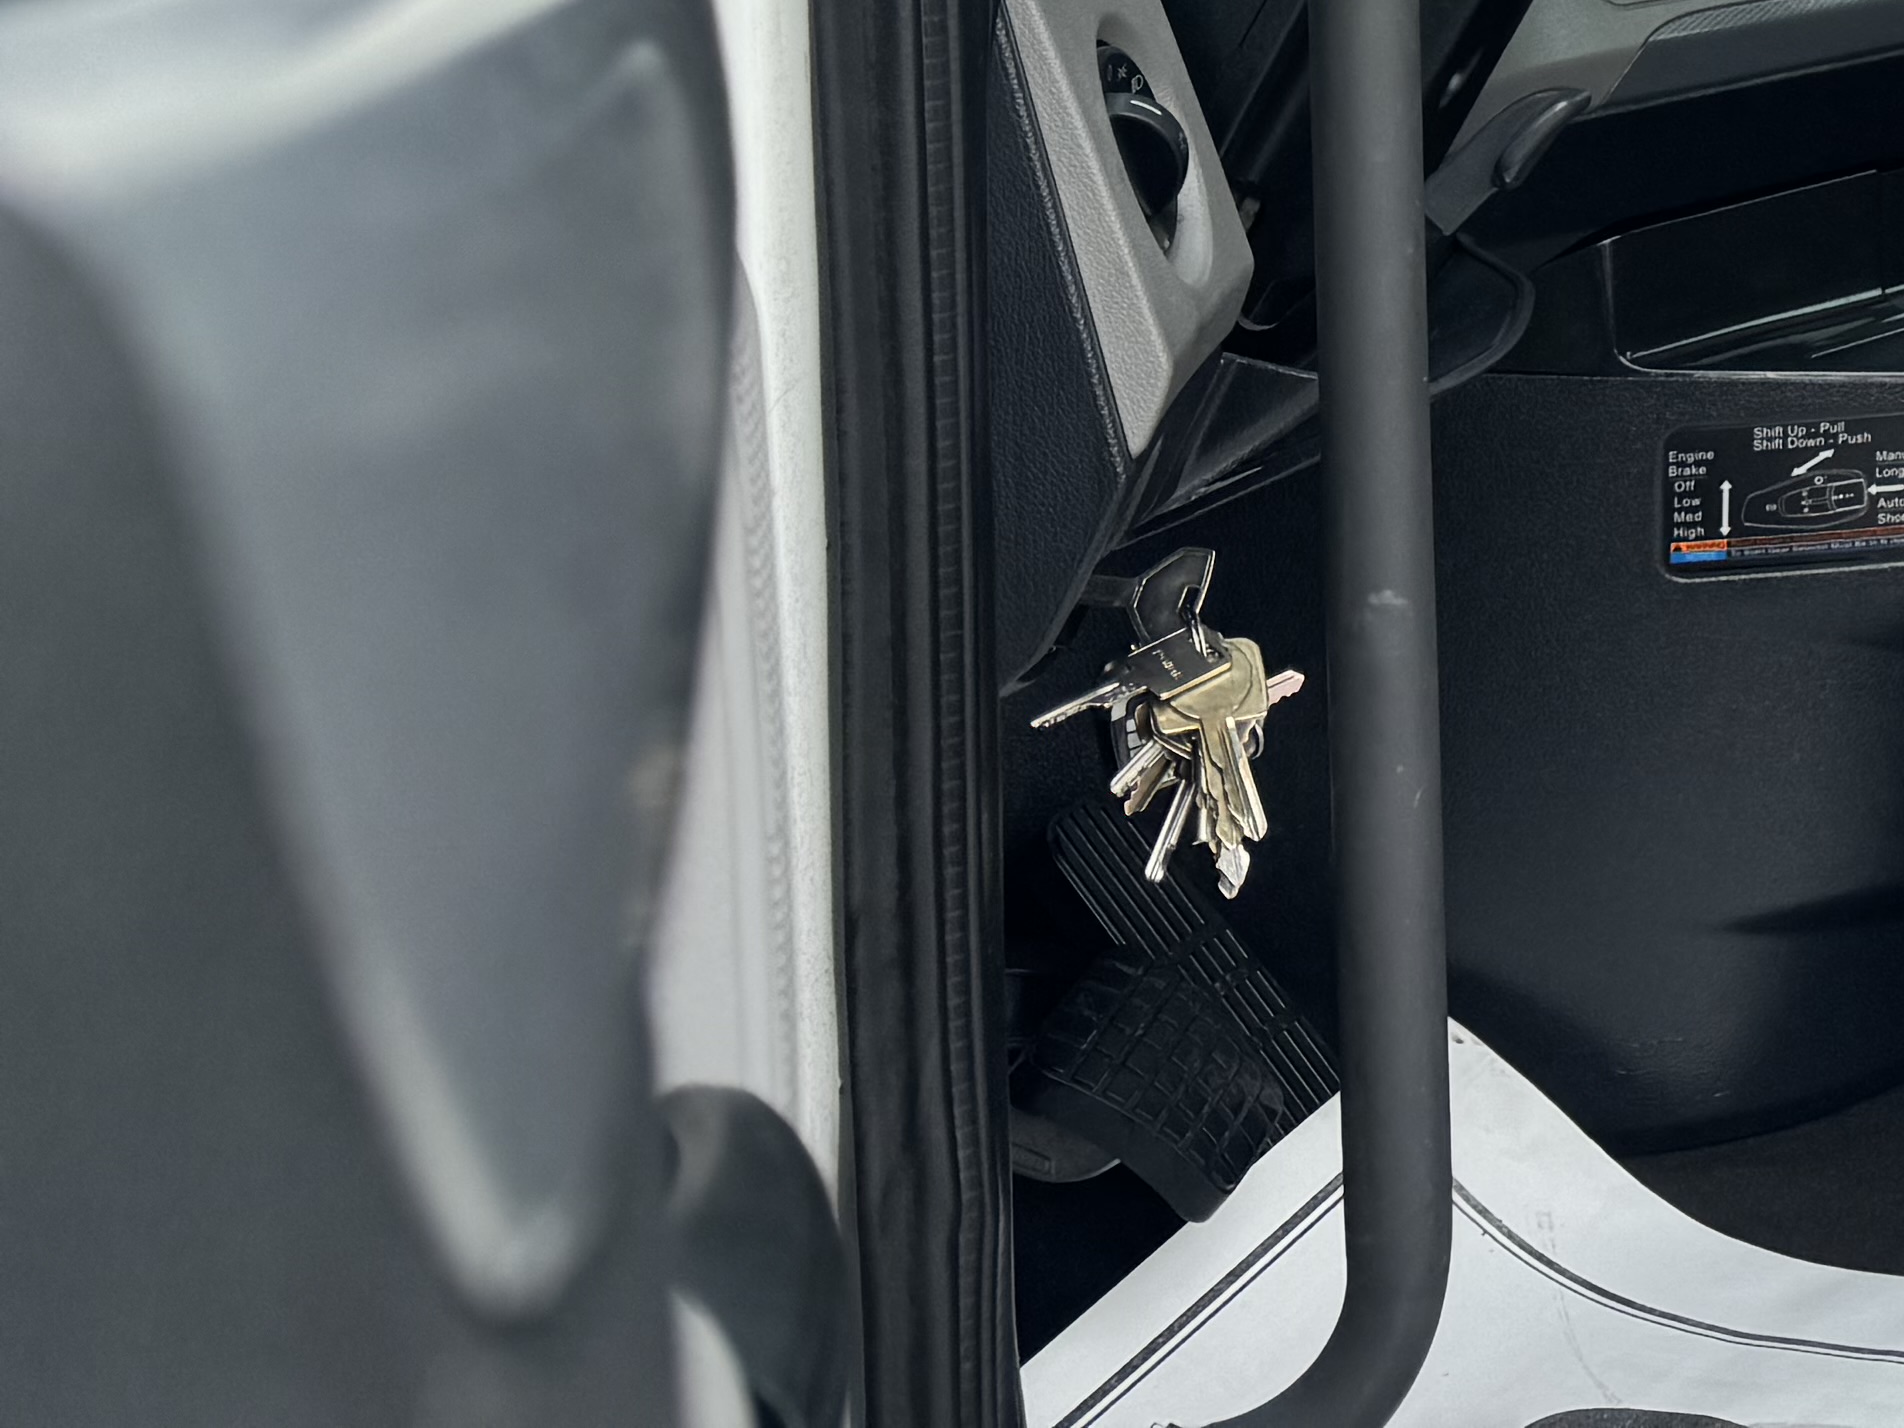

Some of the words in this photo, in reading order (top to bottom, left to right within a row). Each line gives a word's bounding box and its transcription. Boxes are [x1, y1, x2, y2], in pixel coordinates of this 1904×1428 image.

[1753, 427, 1783, 438] Shift
[1788, 425, 1806, 438] Up
[1820, 421, 1845, 434] Pull
[1753, 439, 1783, 451] Shift
[1788, 437, 1825, 448] Down
[1838, 432, 1872, 444] Push
[1668, 450, 1714, 464] Engine
[1668, 465, 1707, 477] Brake
[1876, 466, 1904, 478] Long
[1674, 480, 1695, 492] Off
[1674, 497, 1701, 508] Low
[1674, 511, 1702, 523] Med
[1674, 527, 1705, 540] High
